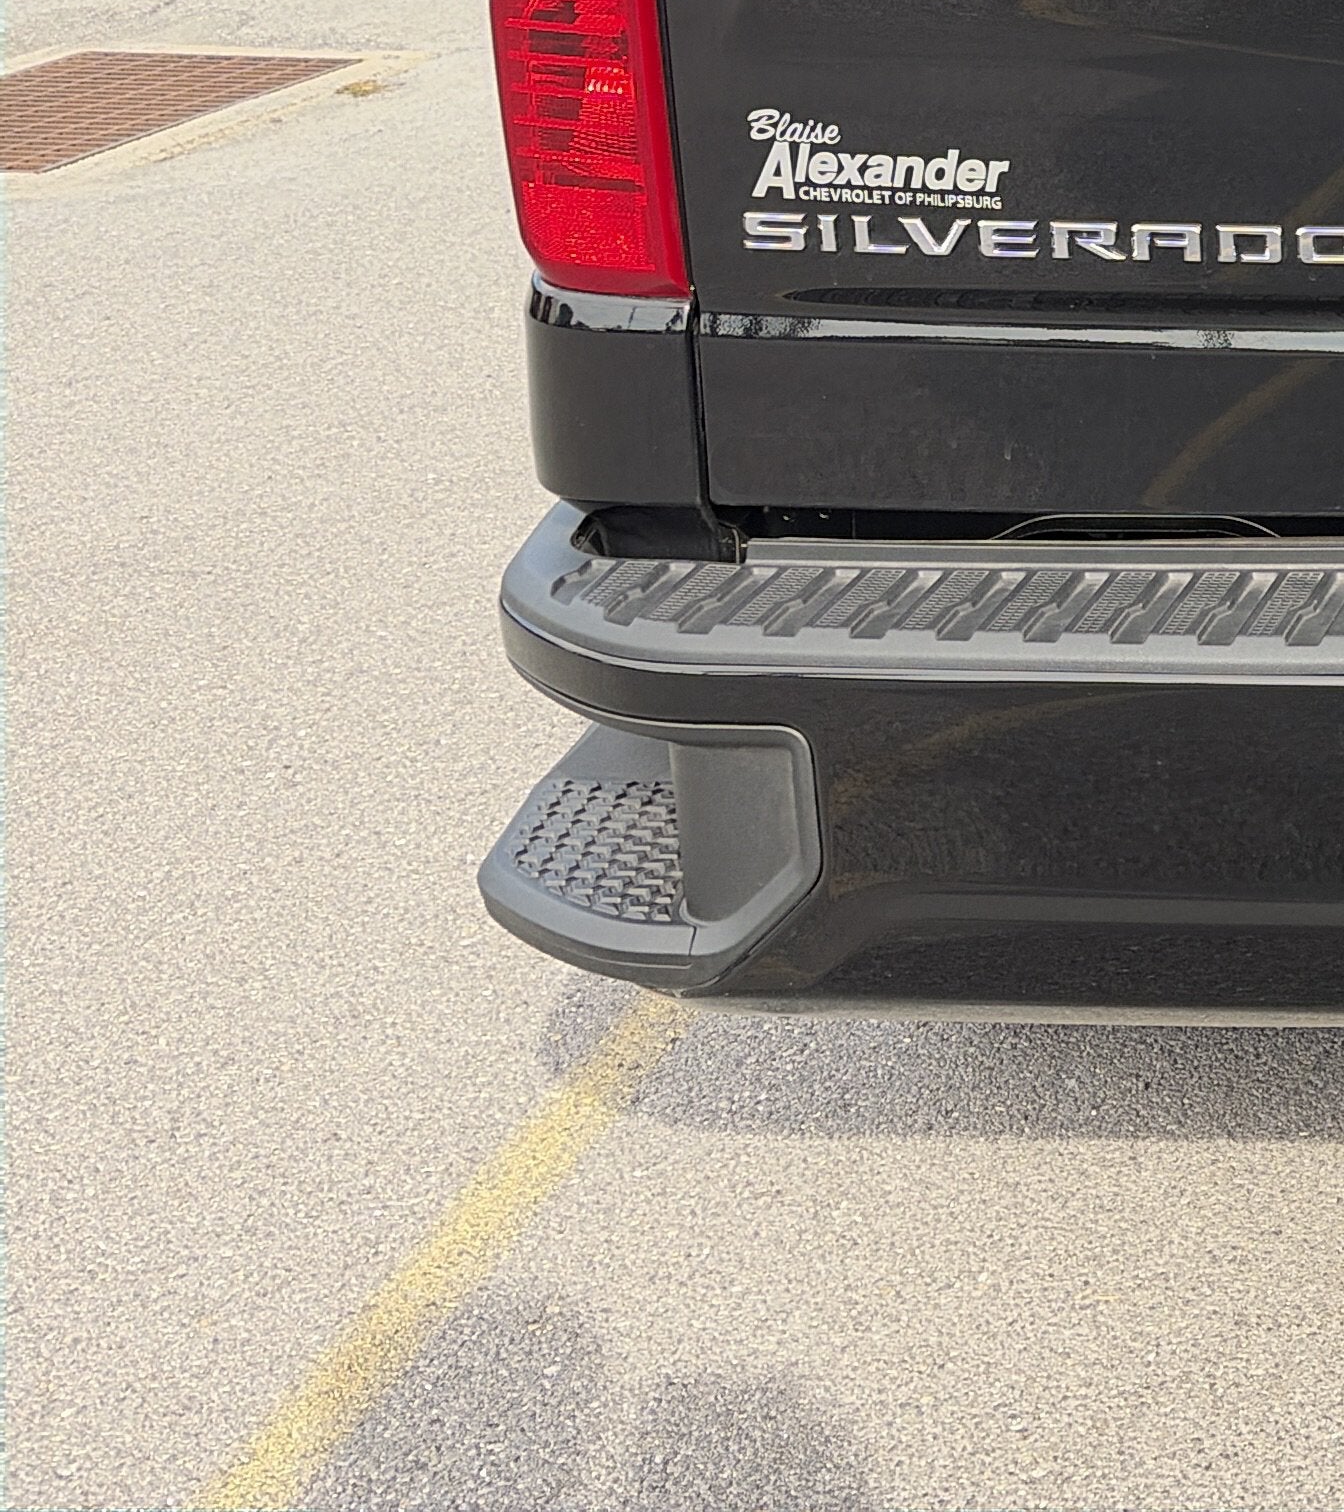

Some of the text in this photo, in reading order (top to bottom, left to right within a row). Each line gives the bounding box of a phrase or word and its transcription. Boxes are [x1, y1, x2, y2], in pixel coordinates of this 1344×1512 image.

[747, 108, 842, 145] Blaise
[751, 140, 1010, 199] Alexander
[798, 186, 1003, 209] CHEVROLET OF PHILIPSBURG
